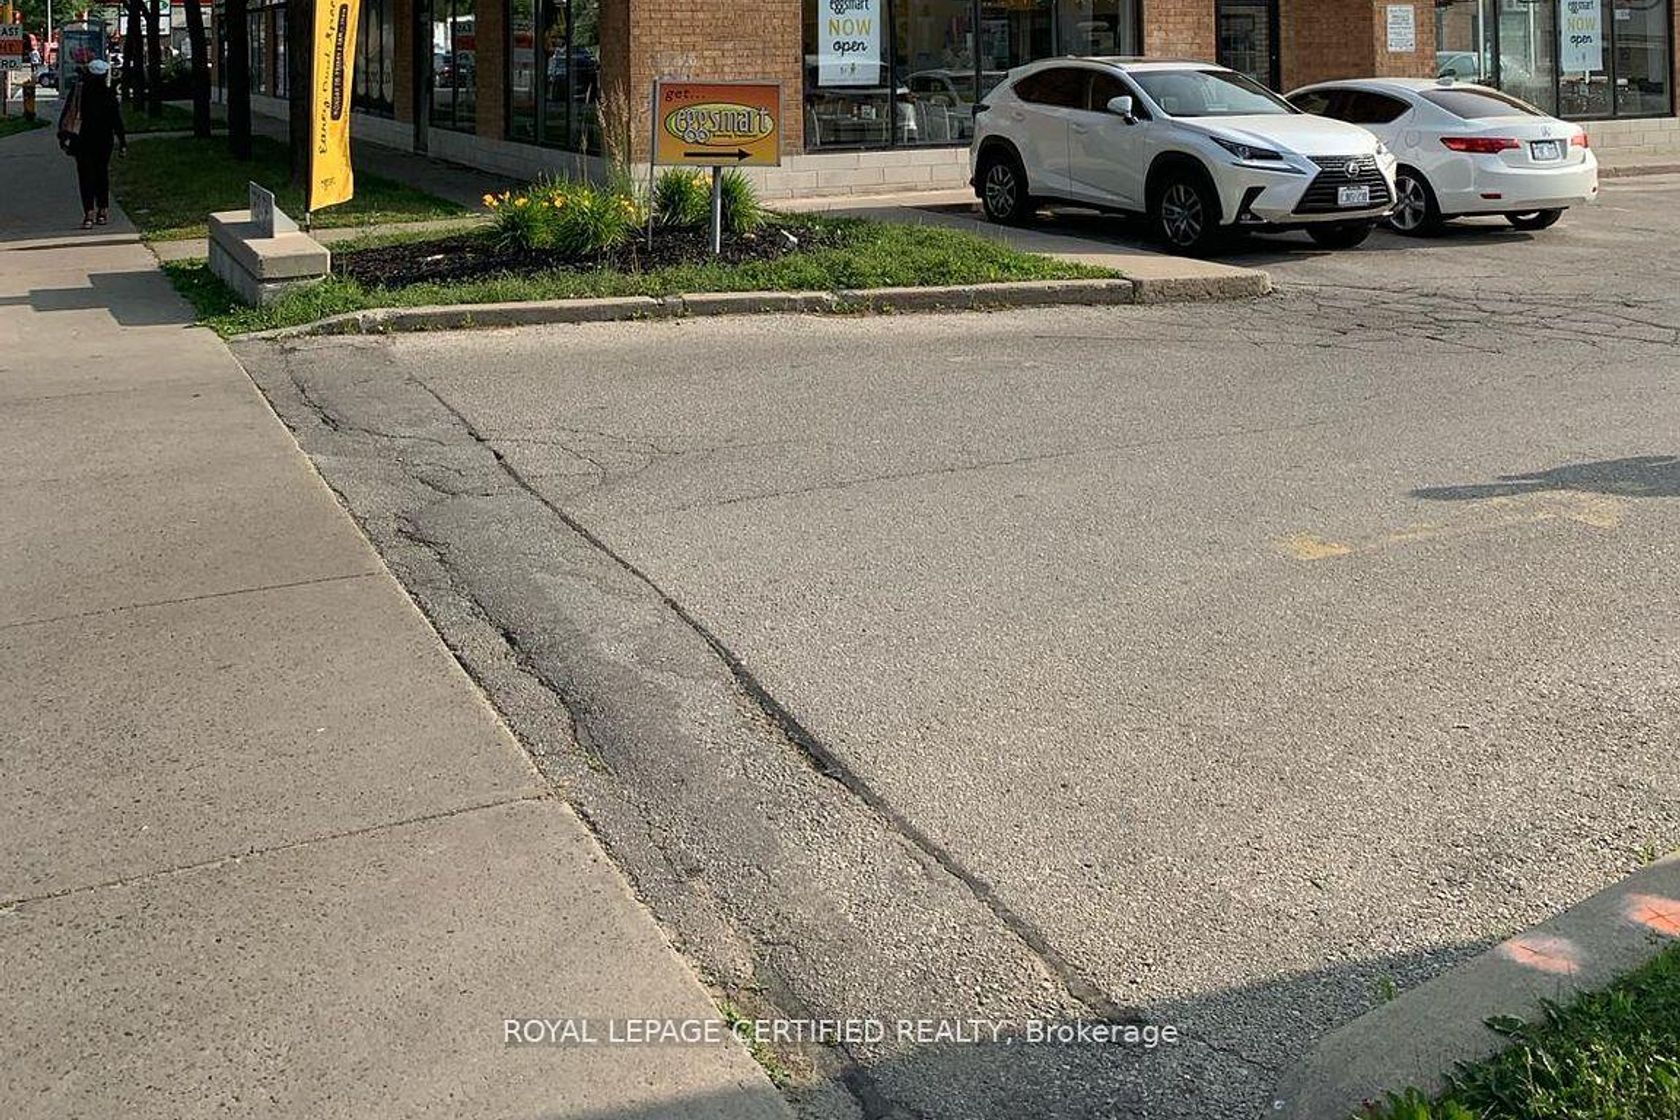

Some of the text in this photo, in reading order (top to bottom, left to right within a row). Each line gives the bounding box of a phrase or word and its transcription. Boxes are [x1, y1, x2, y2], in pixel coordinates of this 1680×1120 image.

[829, 18, 872, 36] NOW
[1567, 16, 1595, 32] NOW
[832, 40, 868, 57] open
[674, 106, 770, 144] eggsmart
